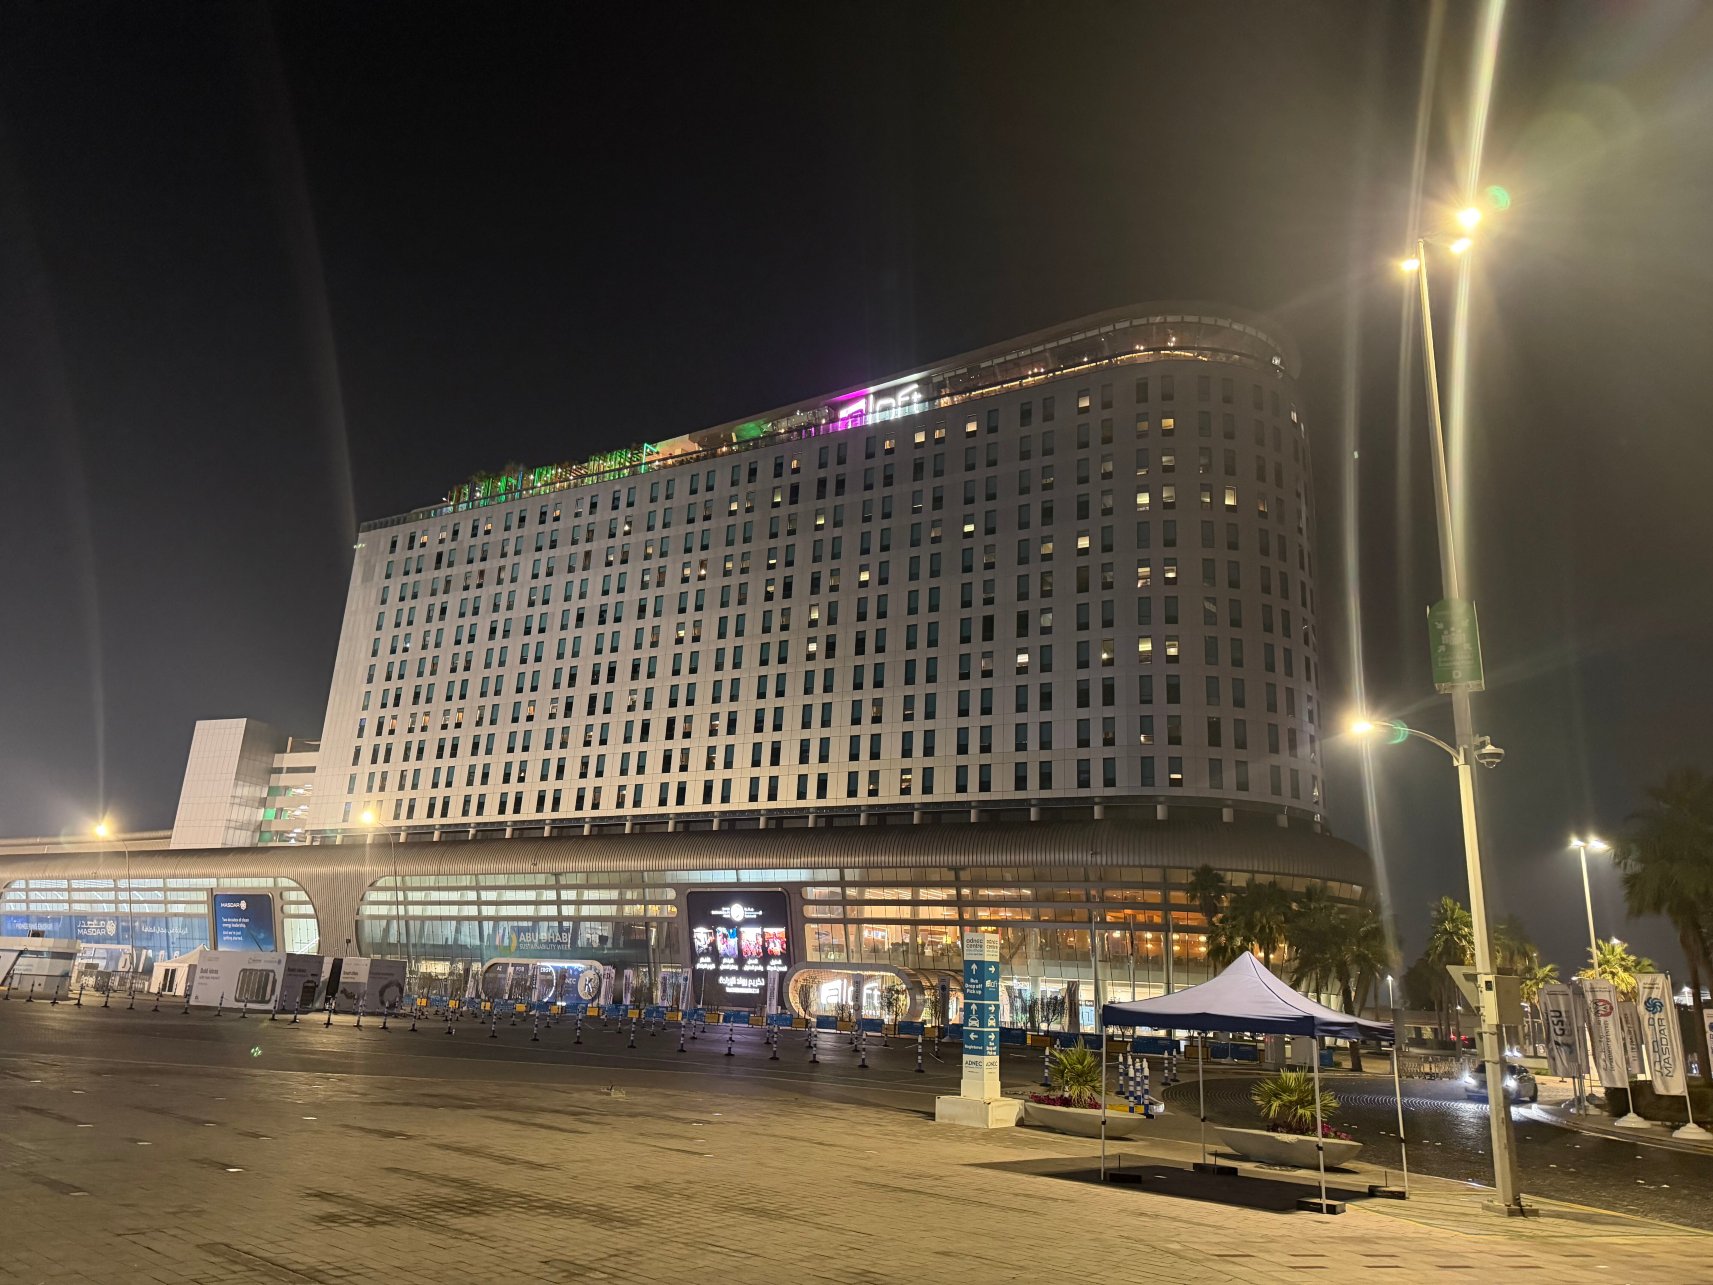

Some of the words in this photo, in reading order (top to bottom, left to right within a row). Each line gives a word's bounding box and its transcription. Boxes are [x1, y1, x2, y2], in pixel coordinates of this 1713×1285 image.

[520, 932, 538, 942] ABU
[540, 932, 571, 943] DHABI
[1550, 1010, 1565, 1036] GSU
[1658, 1018, 1674, 1078] MASDAR
